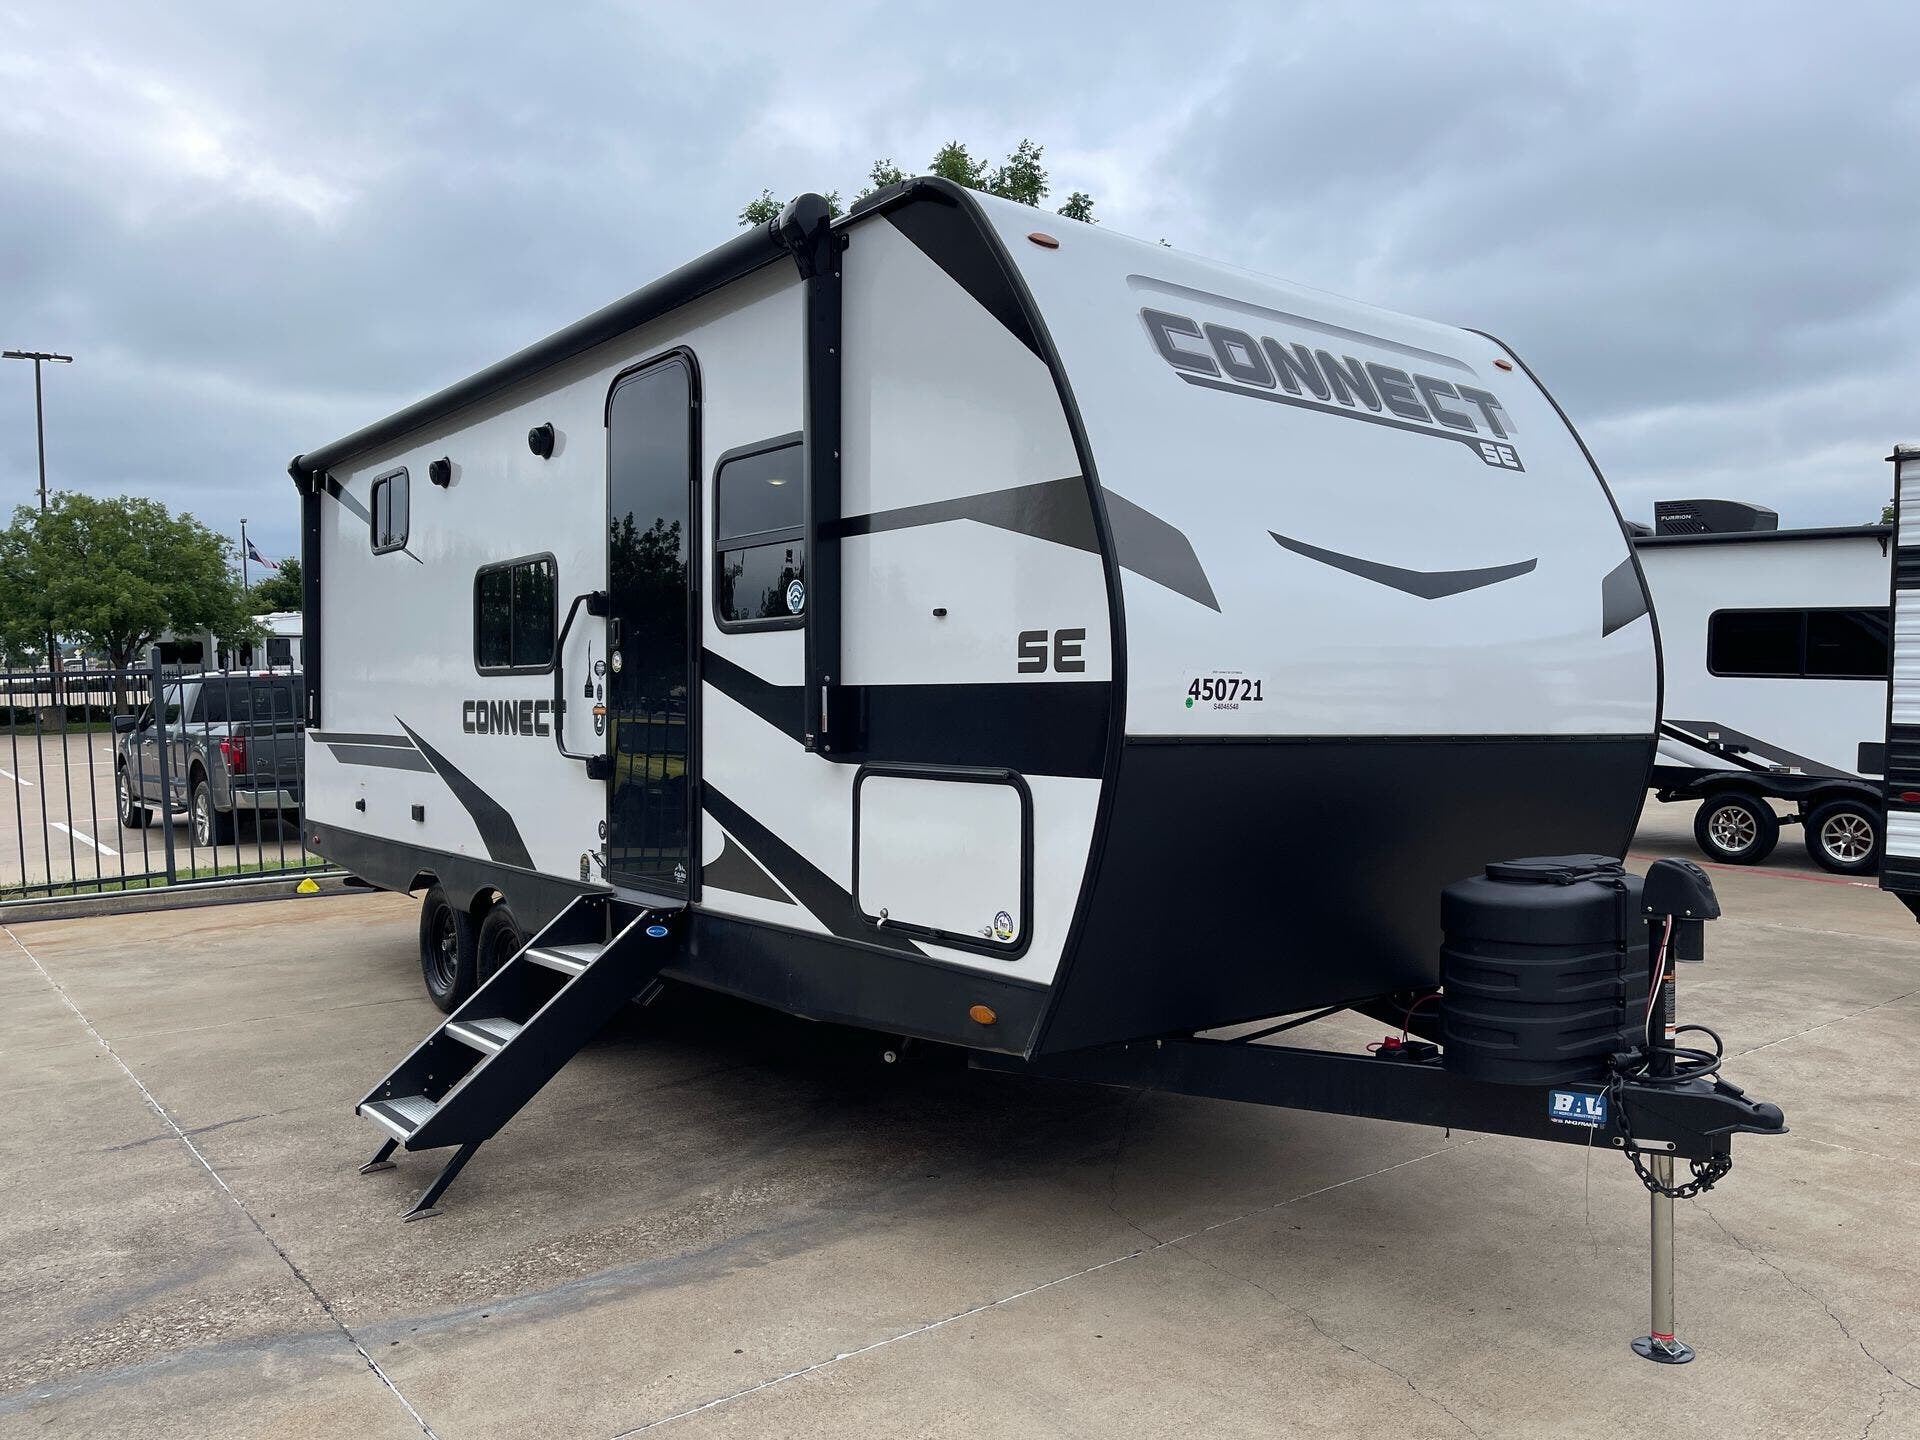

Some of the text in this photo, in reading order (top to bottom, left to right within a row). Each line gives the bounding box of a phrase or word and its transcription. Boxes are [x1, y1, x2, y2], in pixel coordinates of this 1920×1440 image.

[1139, 306, 1510, 440] CONNECT
[1480, 442, 1519, 468] SE
[1018, 628, 1086, 673] SE
[1188, 678, 1263, 701] 450721
[463, 699, 567, 737] CONNEC
[1553, 1093, 1603, 1116] BAL
